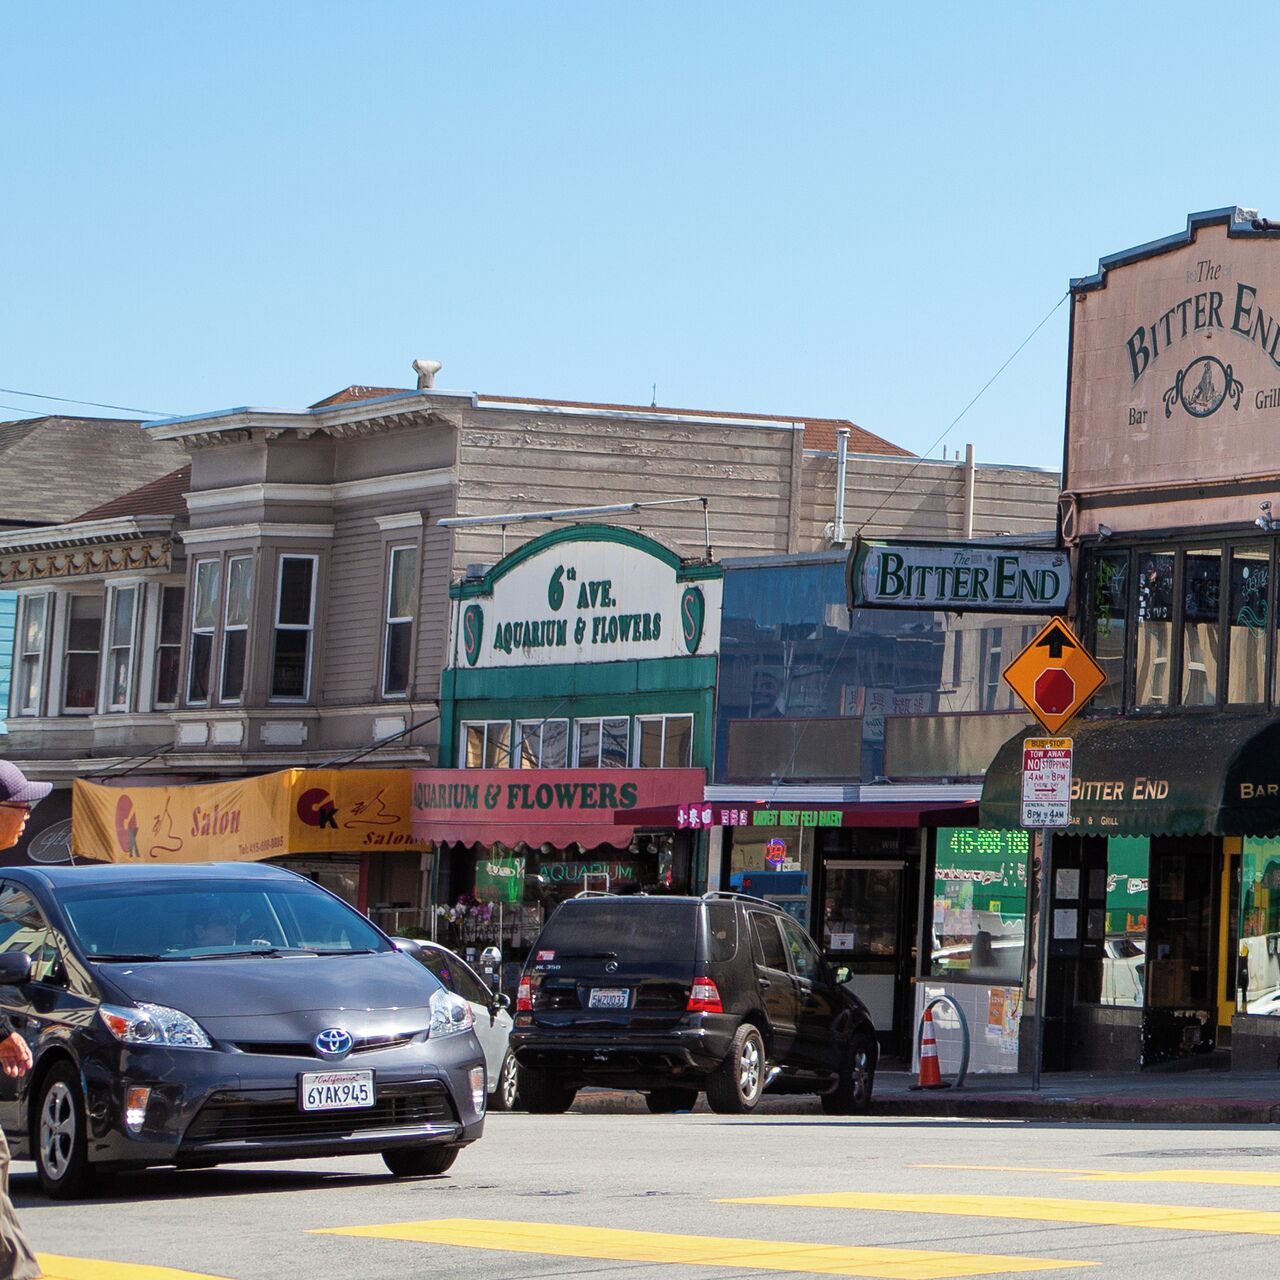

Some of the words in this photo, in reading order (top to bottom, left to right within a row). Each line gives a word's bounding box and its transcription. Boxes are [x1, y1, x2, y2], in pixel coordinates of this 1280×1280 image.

[1197, 259, 1222, 282] The
[1128, 407, 1148, 426] Bar
[1255, 388, 1280, 410] Grill
[953, 552, 971, 566] The
[548, 566, 577, 611] 6th
[577, 580, 616, 609] AVE.
[493, 619, 567, 655] AQUARIUM
[574, 620, 585, 645] &
[592, 613, 661, 645] FLOWERS
[1027, 759, 1040, 770] NO
[1042, 760, 1070, 769] STOPPING
[1030, 750, 1044, 758] TOW
[1047, 750, 1066, 758] AWAY
[412, 783, 479, 810] AQUARIUM
[484, 784, 501, 810] &
[507, 782, 638, 810] FLOWERS
[1132, 776, 1169, 800] END
[1240, 783, 1280, 799] BAR
[191, 804, 241, 837] Salon
[1087, 816, 1093, 825] &
[1100, 816, 1119, 826] GRILL
[363, 831, 418, 845] Salon
[539, 863, 633, 882] AQUARIUM
[308, 1084, 369, 1105] 6YAK945
